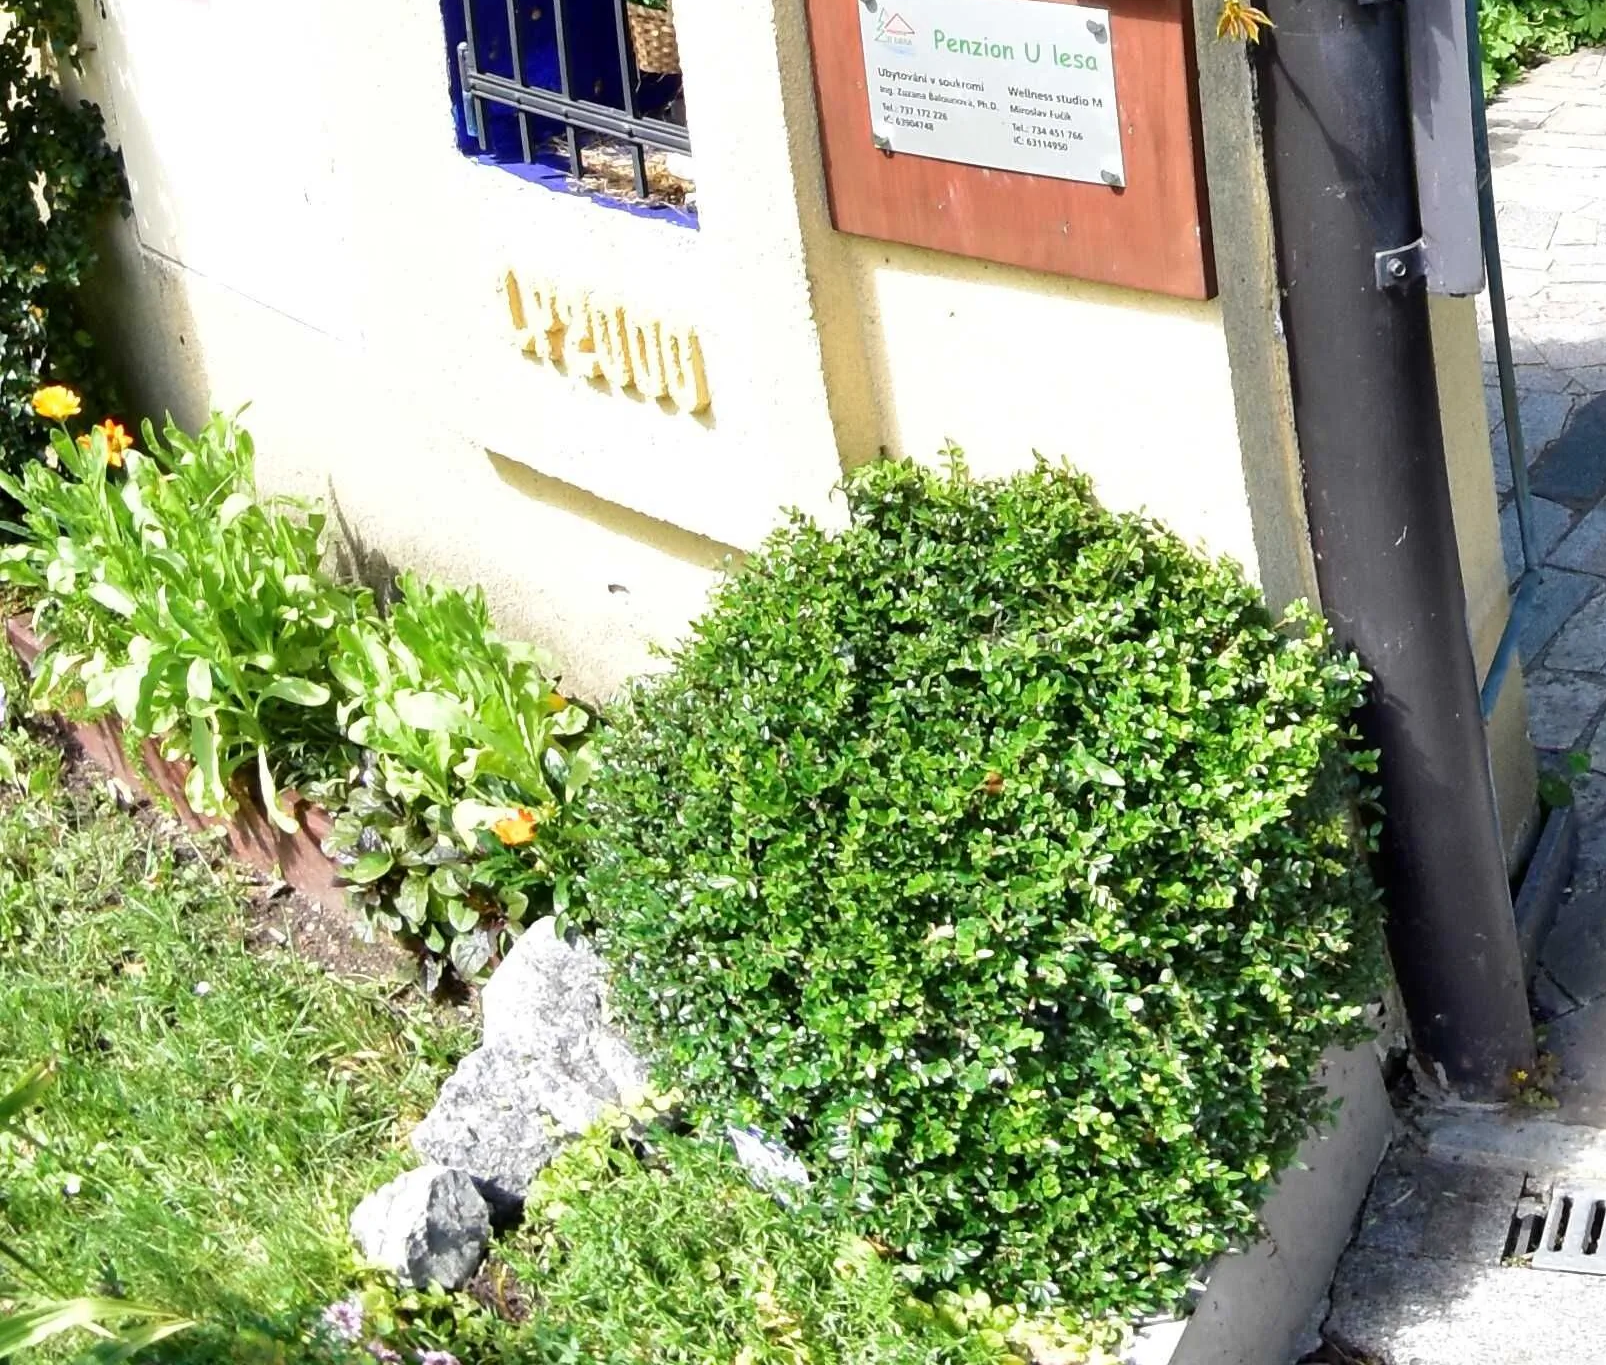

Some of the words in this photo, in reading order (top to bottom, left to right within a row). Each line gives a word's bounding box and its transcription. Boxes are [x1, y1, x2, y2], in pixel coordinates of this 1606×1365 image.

[934, 29, 1014, 60] Penzion
[1024, 42, 1041, 63] U
[1053, 44, 1099, 71] lesa
[930, 77, 936, 85] v
[1007, 86, 1054, 101] Wellness
[1056, 94, 1089, 107] studio
[1092, 98, 1103, 108] M
[1010, 104, 1047, 118] Miroslav
[1031, 125, 1047, 135] 734
[1049, 128, 1064, 138] 451
